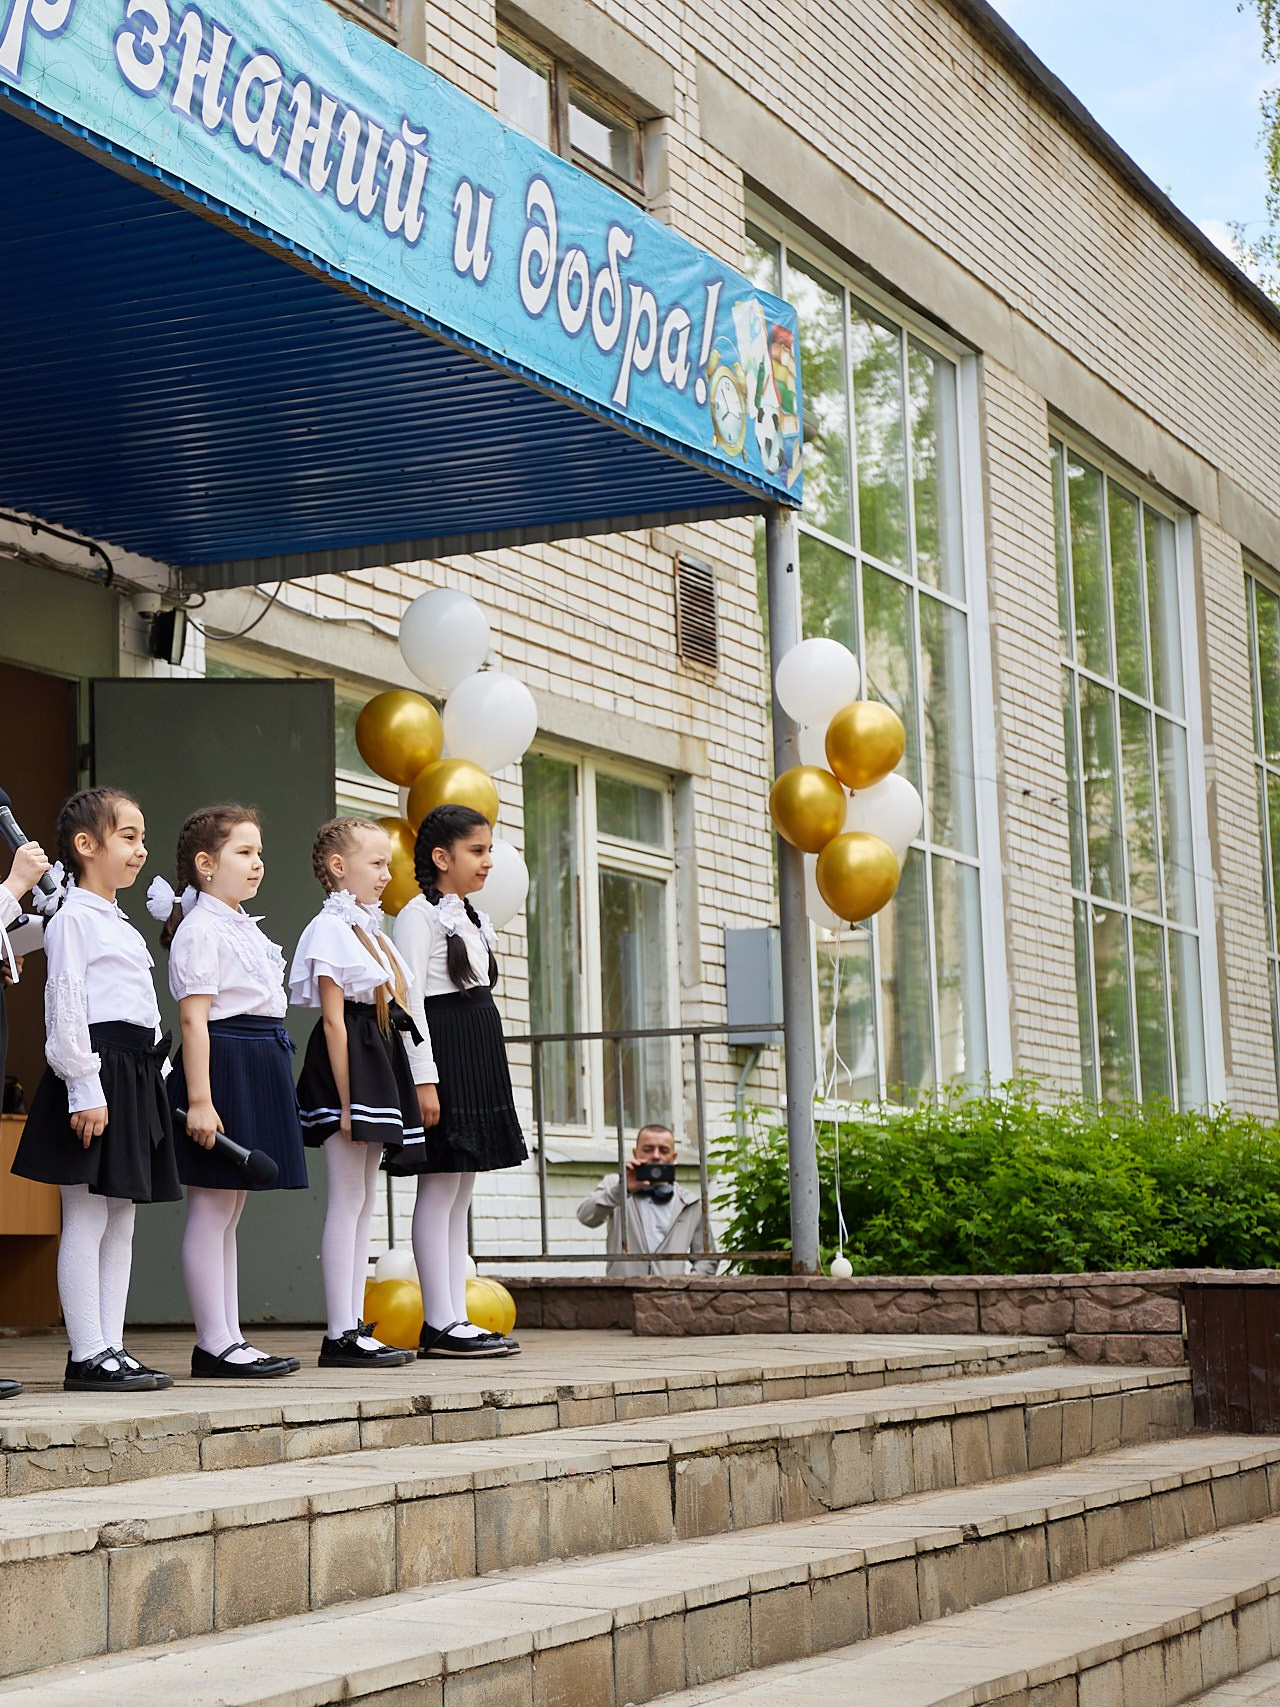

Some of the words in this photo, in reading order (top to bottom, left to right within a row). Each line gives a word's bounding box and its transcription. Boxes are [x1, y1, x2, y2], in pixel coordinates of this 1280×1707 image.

[113, 0, 432, 248] знаний
[450, 176, 496, 285] и
[517, 172, 725, 409] добра!
